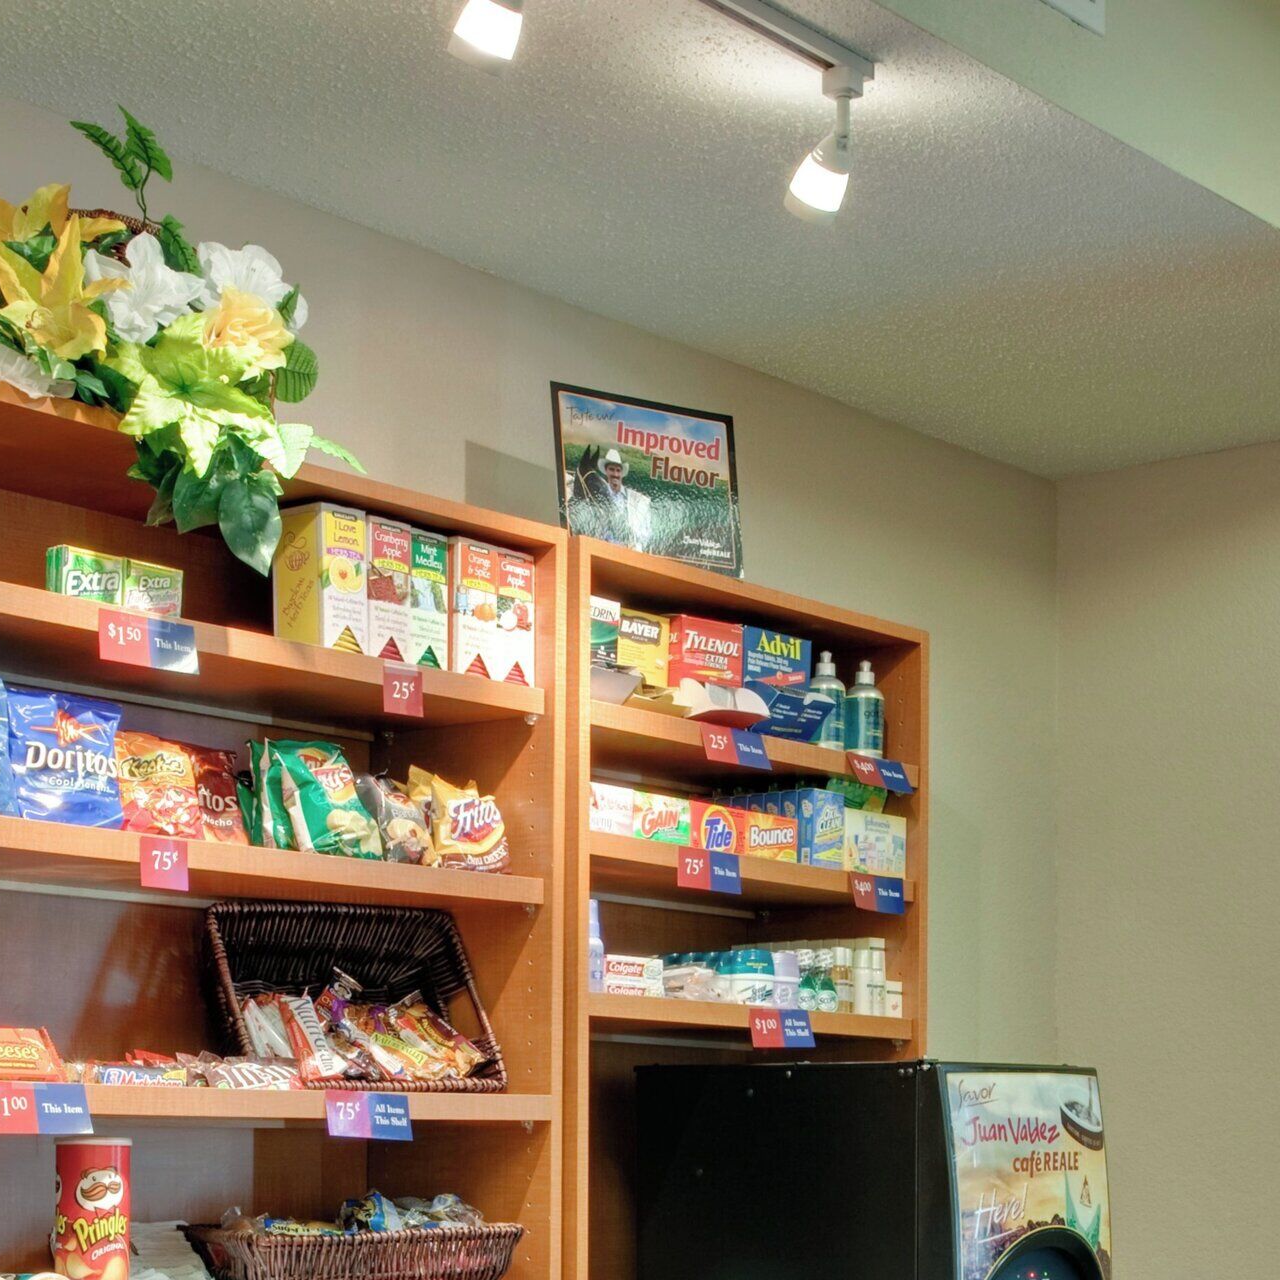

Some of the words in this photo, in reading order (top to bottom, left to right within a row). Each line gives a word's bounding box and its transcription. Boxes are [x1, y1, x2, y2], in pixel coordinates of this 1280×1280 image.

[616, 421, 722, 462] Improved
[650, 456, 721, 490] Flavor
[374, 530, 410, 552] Cranberry
[67, 569, 120, 596] Extra
[138, 575, 171, 592] Extra
[621, 618, 660, 640] BAYER
[683, 628, 740, 657] TYLENOL
[756, 630, 802, 661] Advil
[24, 740, 118, 779] Doritos
[448, 797, 503, 840] Fritos
[641, 808, 681, 836] GAIN
[703, 817, 734, 850] Tide
[750, 825, 794, 847] Bounce
[608, 961, 643, 975] Colgate
[41, 1102, 62, 1114] This
[63, 1103, 83, 1115] Item
[962, 1116, 1008, 1147] Juan
[1007, 1115, 1061, 1145] Valdez
[973, 1182, 1029, 1240] Here!
[73, 1208, 128, 1255] Pringles
